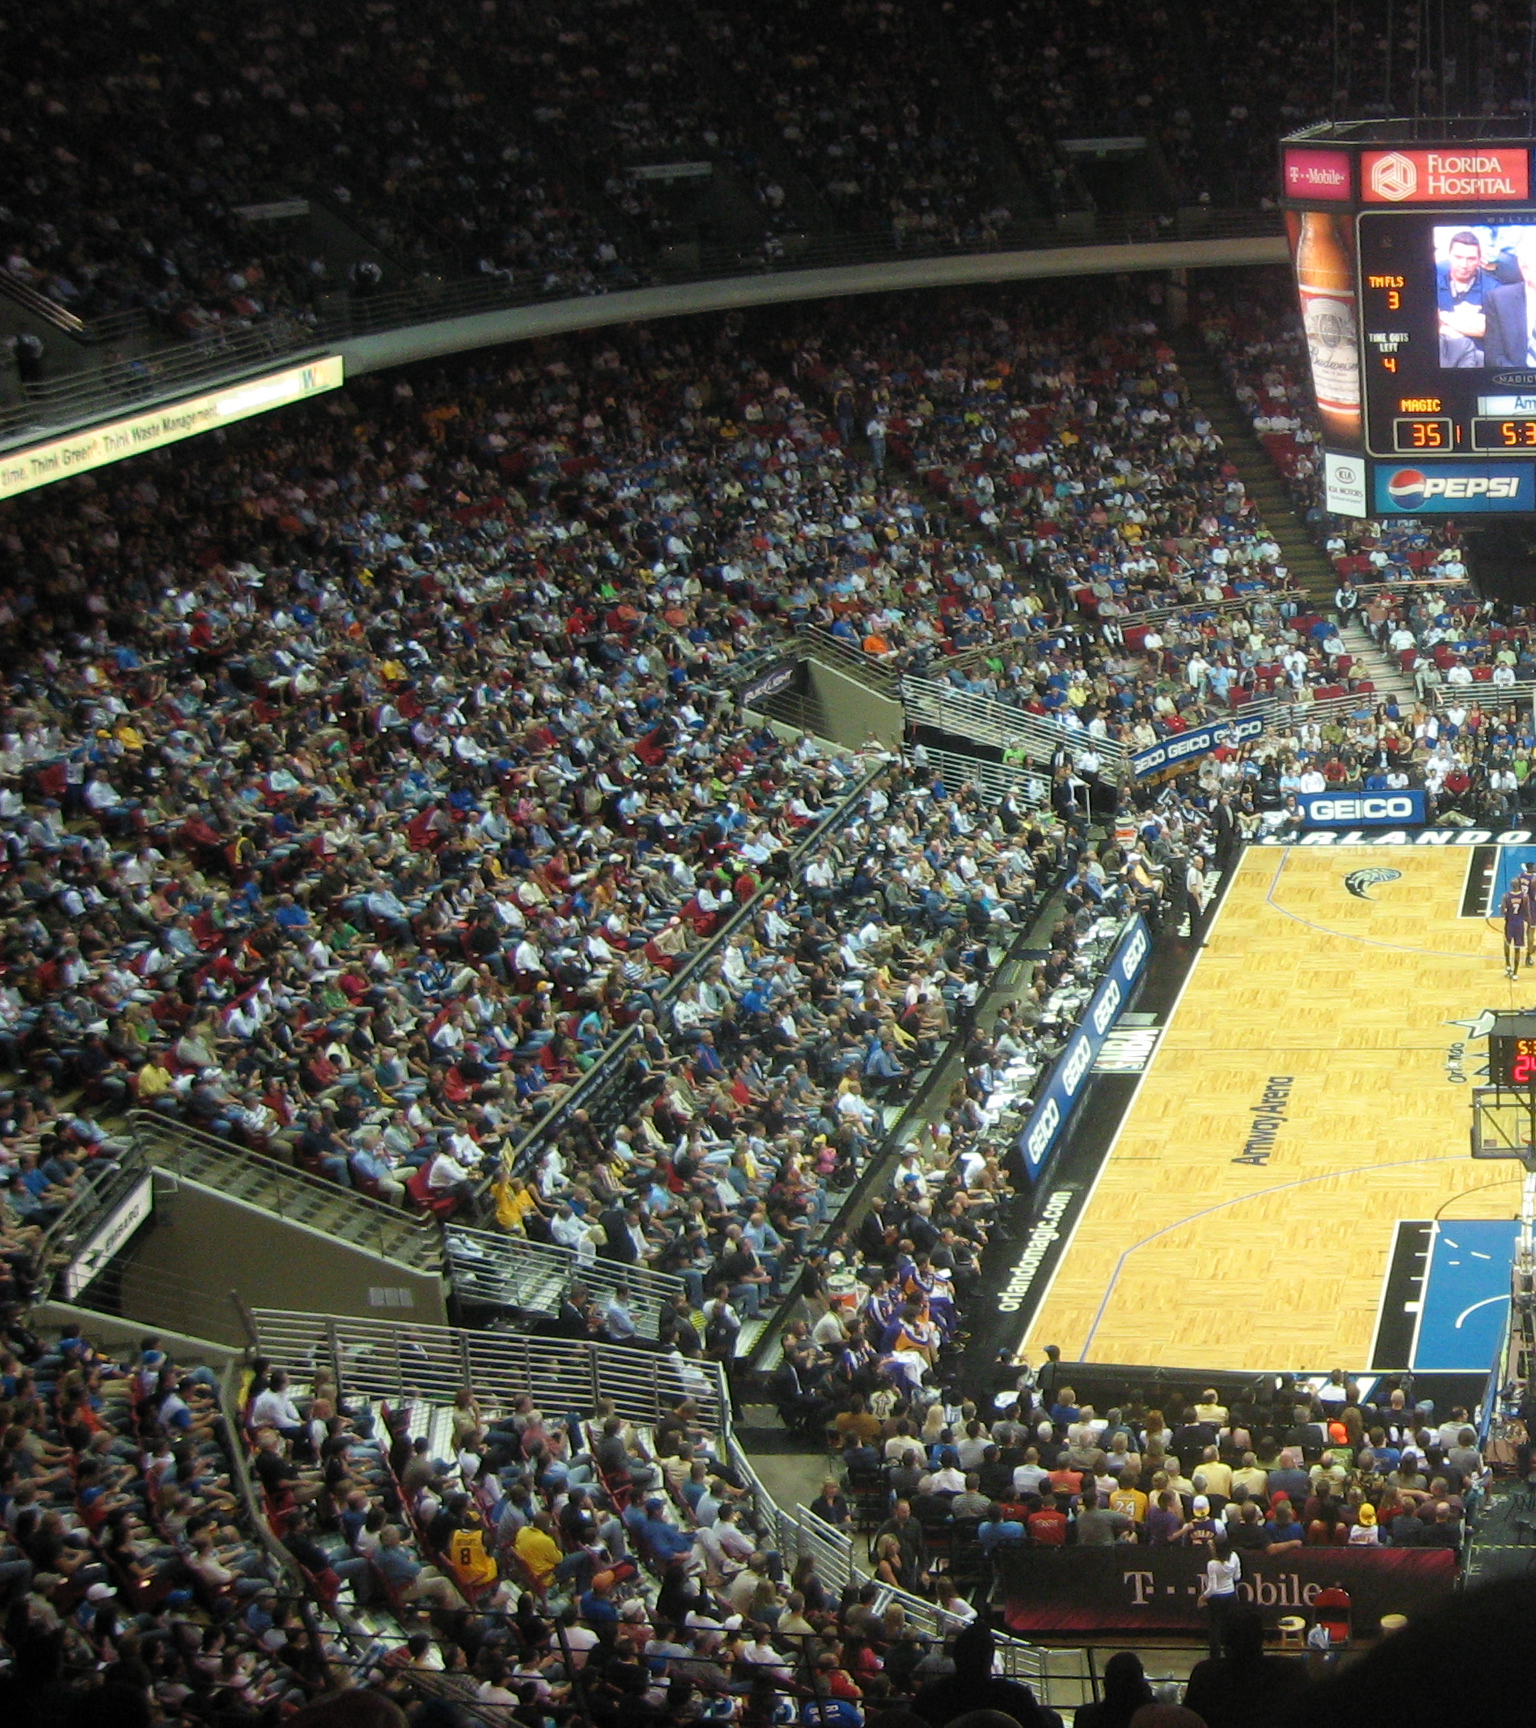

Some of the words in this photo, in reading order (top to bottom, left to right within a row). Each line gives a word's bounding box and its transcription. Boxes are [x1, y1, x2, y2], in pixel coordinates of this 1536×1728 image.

[1428, 154, 1502, 174] FLORIDA
[1428, 175, 1517, 195] HOSPITAL
[1389, 291, 1401, 310] 3
[1384, 357, 1397, 373] 4
[1401, 399, 1441, 412] MAGIC
[1412, 423, 1442, 447] 35
[1423, 477, 1520, 498] PEPSI
[1168, 734, 1210, 759] GEICO
[1213, 721, 1262, 744] GCO
[1309, 797, 1413, 821] GEICO
[1262, 831, 1532, 845] RLANDO
[1122, 929, 1147, 981] GEICO
[1093, 979, 1121, 1035] GEICO
[1062, 1035, 1091, 1097] GEICO
[1249, 1076, 1295, 1114] Arena
[1028, 1098, 1060, 1165] GEICO
[1231, 1114, 1289, 1166] Amway
[998, 1191, 1073, 1312] orlandomagic.com
[1116, 1500, 1136, 1516] 24
